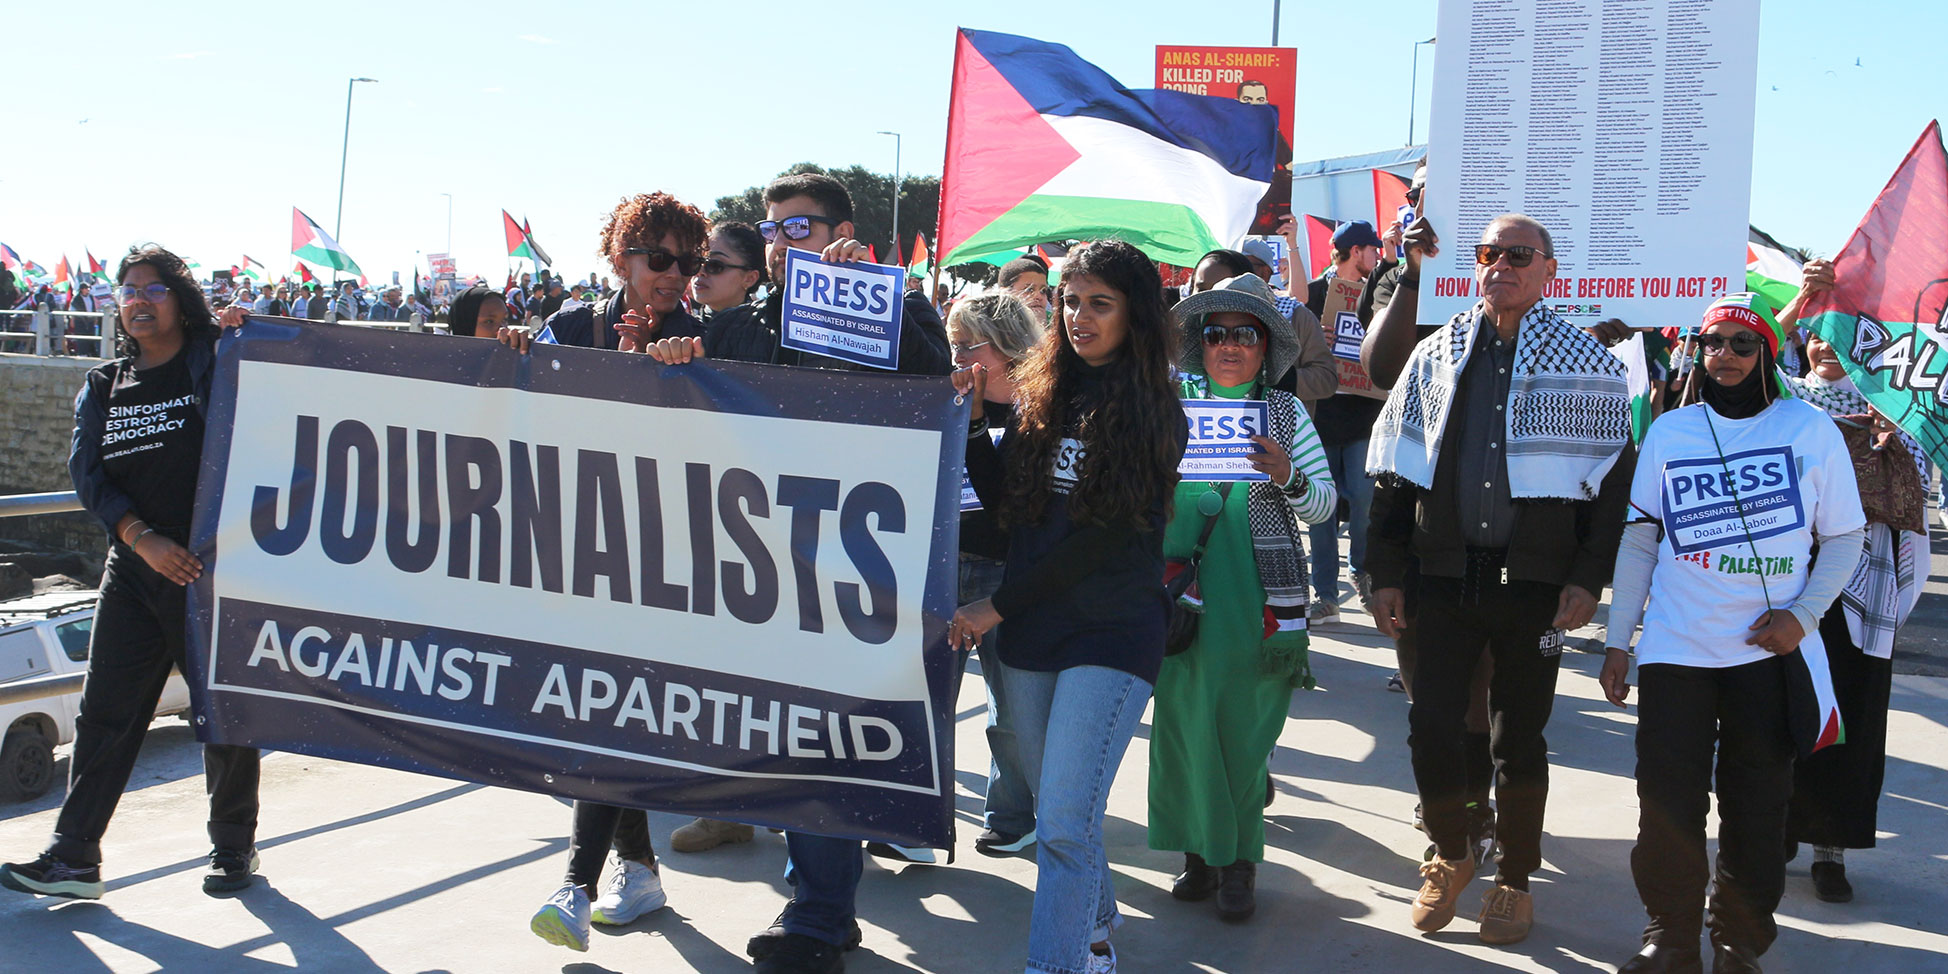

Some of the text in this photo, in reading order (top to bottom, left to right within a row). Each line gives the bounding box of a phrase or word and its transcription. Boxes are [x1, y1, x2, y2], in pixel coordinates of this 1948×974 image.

[1163, 51, 1280, 67] ANAS AL-SHARIF:
[1163, 68, 1244, 83] KILLED FOR
[795, 269, 888, 315] PRESS
[1435, 277, 1471, 297] HOW
[1543, 277, 1727, 298] ORE BEFORE YOU ACT ?!
[1568, 304, 1588, 313] PSC
[792, 309, 886, 335] ASSASSINATED BY ISRAEL
[1341, 320, 1362, 336] PR
[795, 327, 882, 354] Hisham Al-Nawajah
[1850, 311, 1948, 405] PAL
[109, 394, 195, 417] SINFORMATI
[105, 412, 167, 431] ESTROYS
[1186, 415, 1257, 440] RESS
[1180, 461, 1254, 470] l-Rahman Sheha
[1671, 462, 1784, 506] PRESS
[1675, 494, 1788, 525] ASSASSINATED BY ISRAEL
[250, 415, 906, 645] JOURNALISTS
[1693, 525, 1723, 539] Doaa
[247, 619, 903, 761] AGAINST APARTHEID
